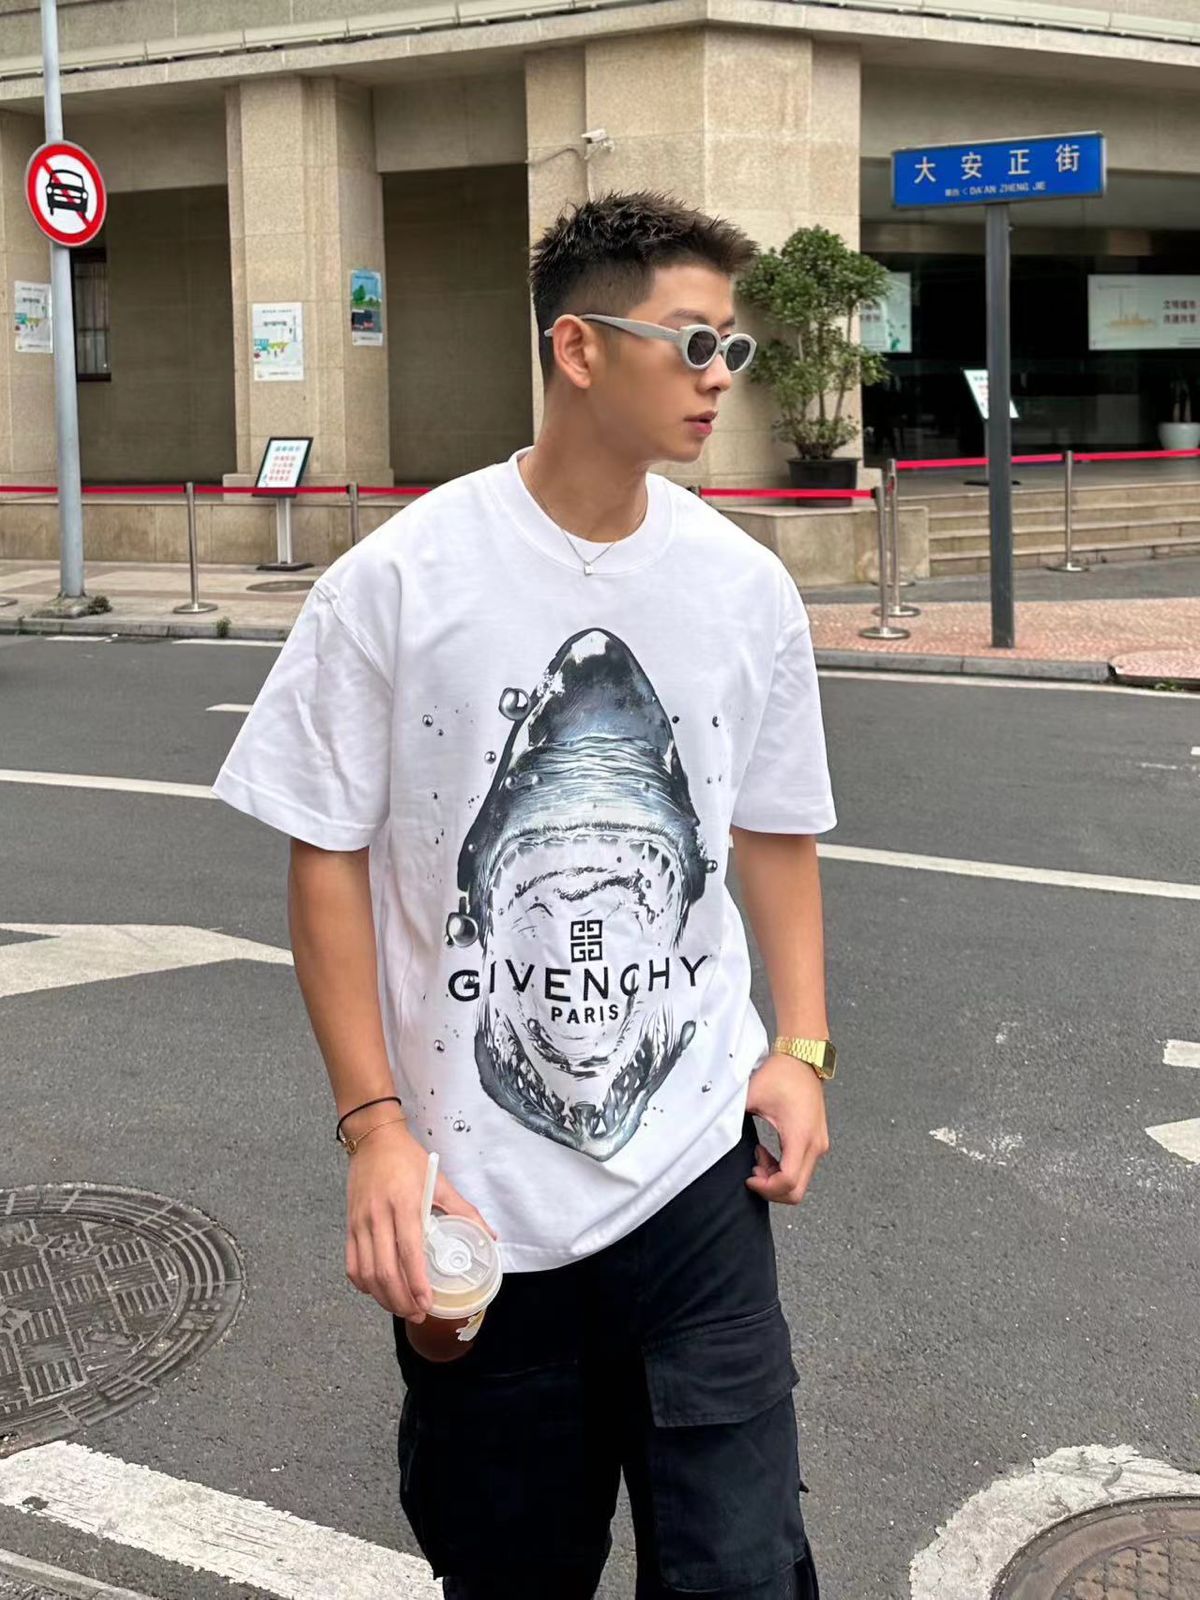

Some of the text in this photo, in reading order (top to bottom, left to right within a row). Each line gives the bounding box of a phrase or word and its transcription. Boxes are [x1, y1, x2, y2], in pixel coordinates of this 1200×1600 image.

[914, 144, 1080, 184] 大安正街
[999, 182, 1029, 193] ZHENG
[1032, 181, 1046, 191] JIE
[448, 955, 708, 1002] GIVENCHY
[551, 1004, 619, 1024] PARIS
